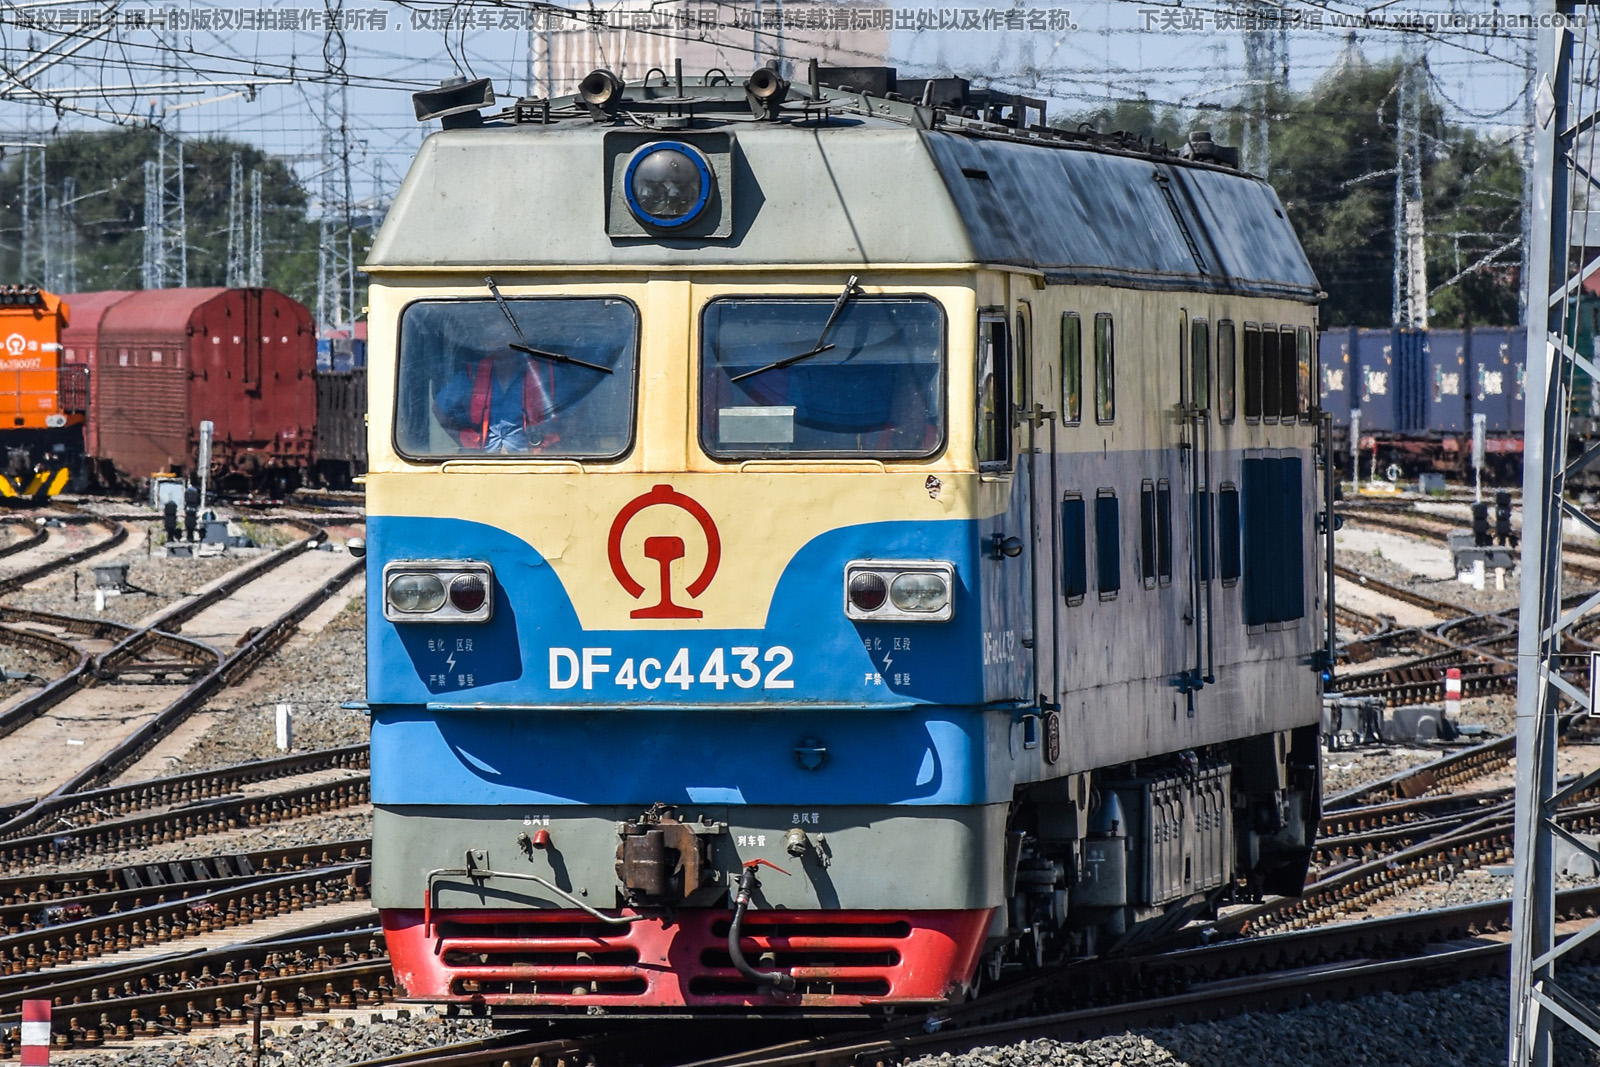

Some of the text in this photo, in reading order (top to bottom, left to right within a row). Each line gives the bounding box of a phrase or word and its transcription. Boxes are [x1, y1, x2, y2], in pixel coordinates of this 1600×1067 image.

[549, 646, 794, 690] DF4C4432
[864, 672, 882, 686] 严禁
[522, 814, 551, 826] 总风管
[791, 812, 820, 824] 总风管
[737, 834, 766, 847] 列车管
